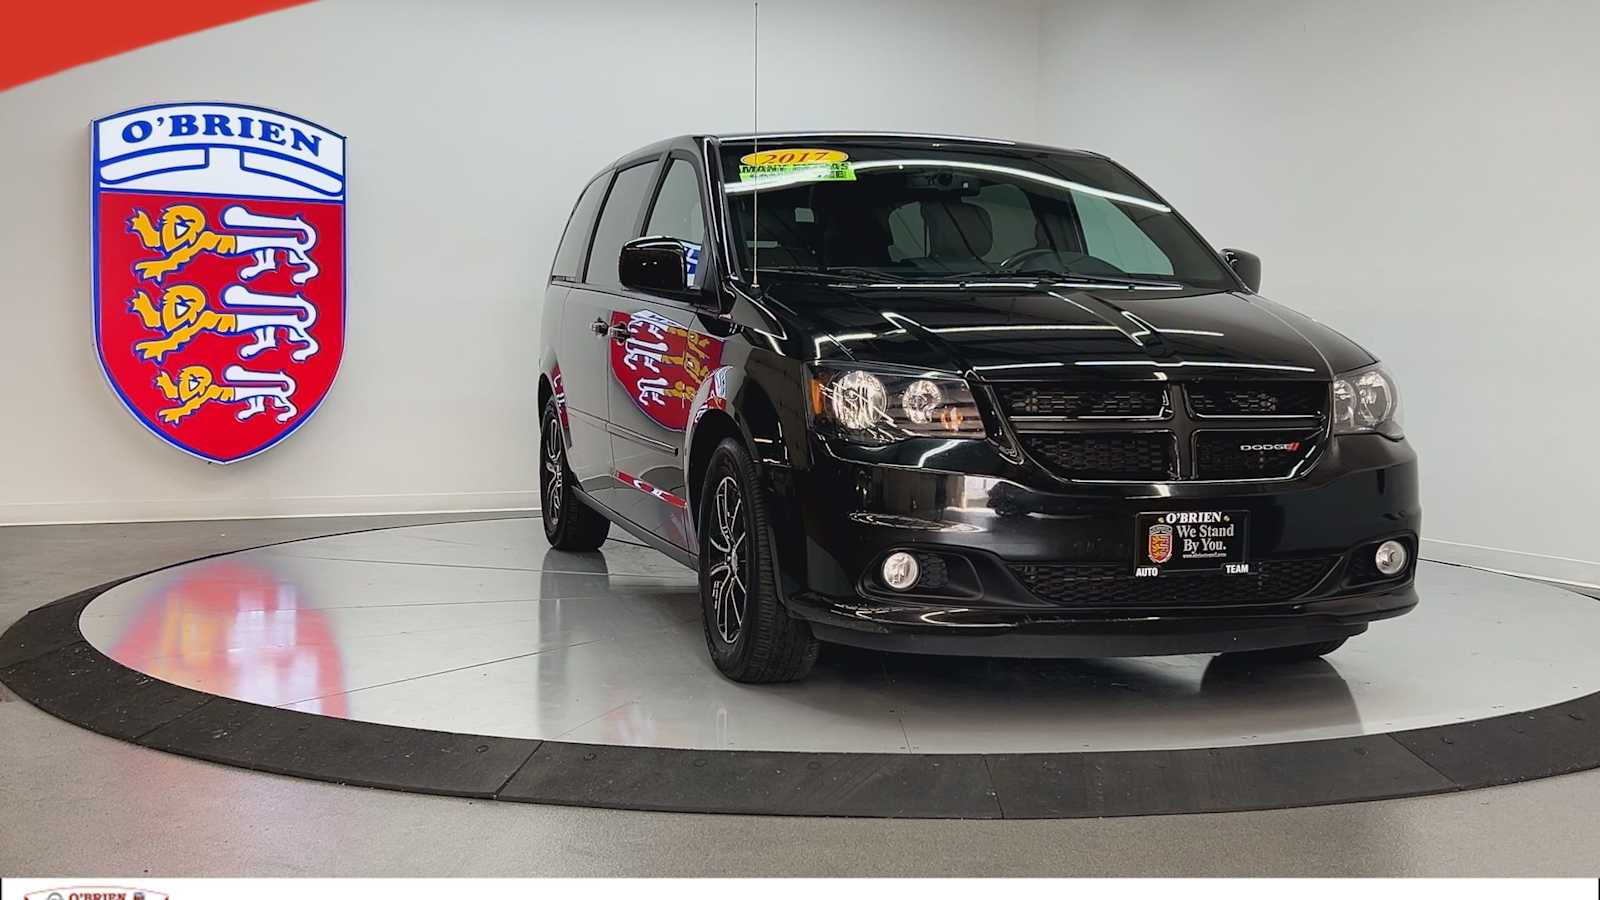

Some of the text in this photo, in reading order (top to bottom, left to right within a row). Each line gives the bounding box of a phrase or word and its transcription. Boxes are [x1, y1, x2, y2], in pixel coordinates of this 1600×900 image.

[122, 114, 322, 157] O'BRIEN
[761, 152, 829, 164] 2017
[1166, 512, 1222, 523] O'BRIEN
[1176, 525, 1197, 538] We
[1199, 524, 1234, 537] Stand
[1183, 538, 1227, 554] By You.
[1135, 567, 1158, 577] AUTO
[1226, 564, 1249, 574] TEAM
